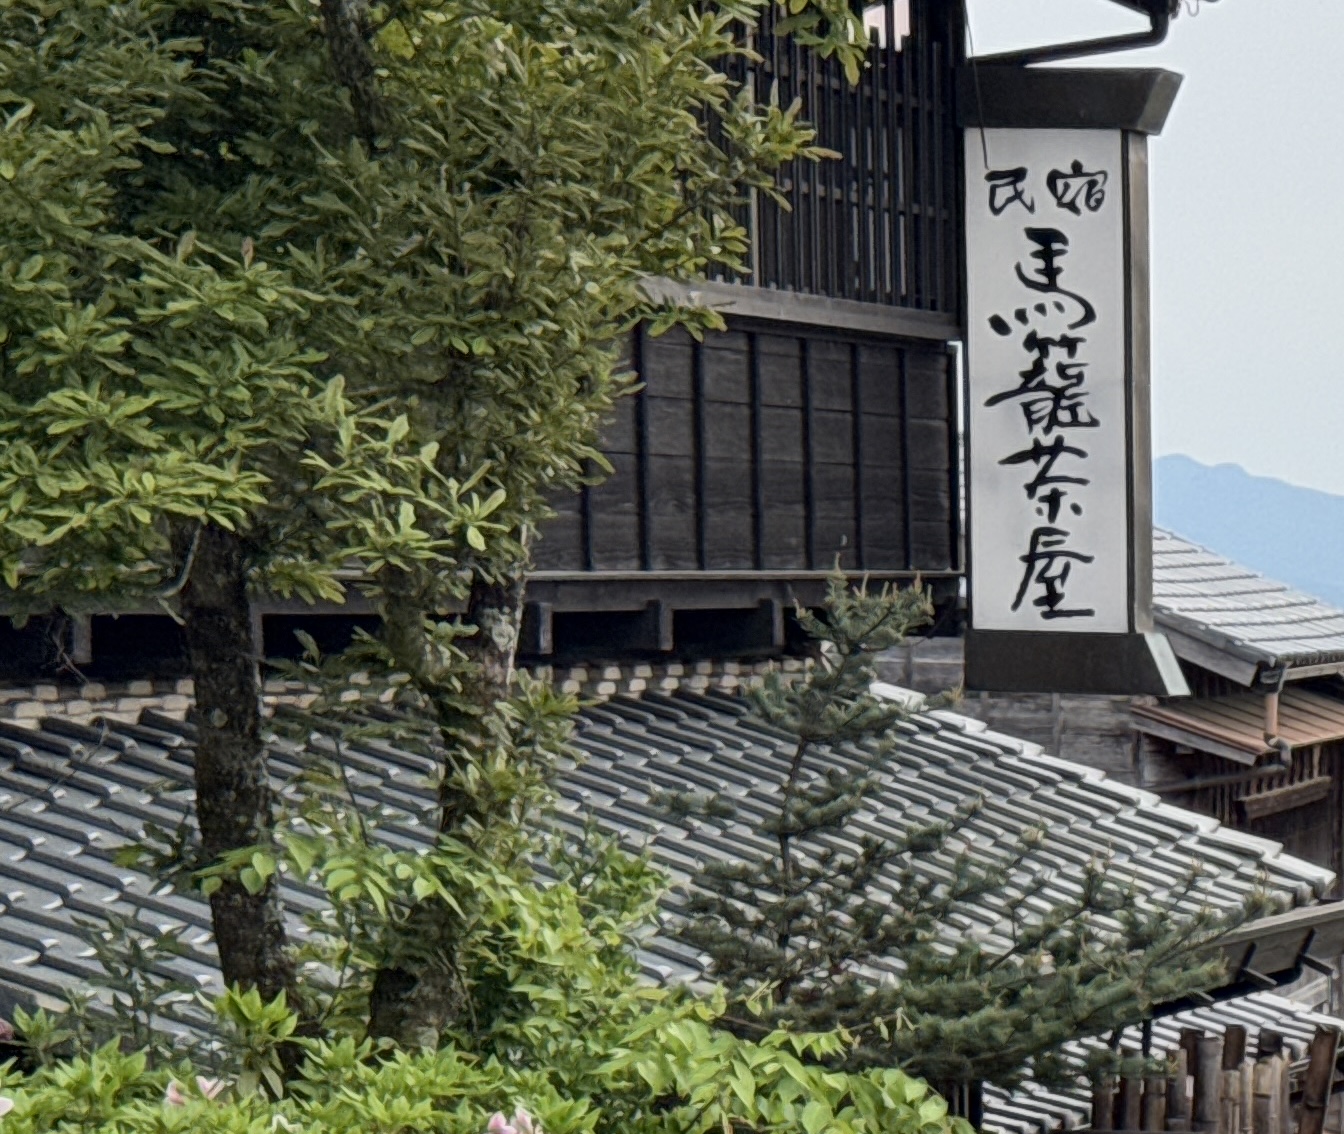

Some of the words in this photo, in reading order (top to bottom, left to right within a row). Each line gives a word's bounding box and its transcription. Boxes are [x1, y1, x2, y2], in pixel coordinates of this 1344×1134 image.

[985, 160, 1108, 216] 民宿
[986, 228, 1099, 618] 馬籠茶屋
